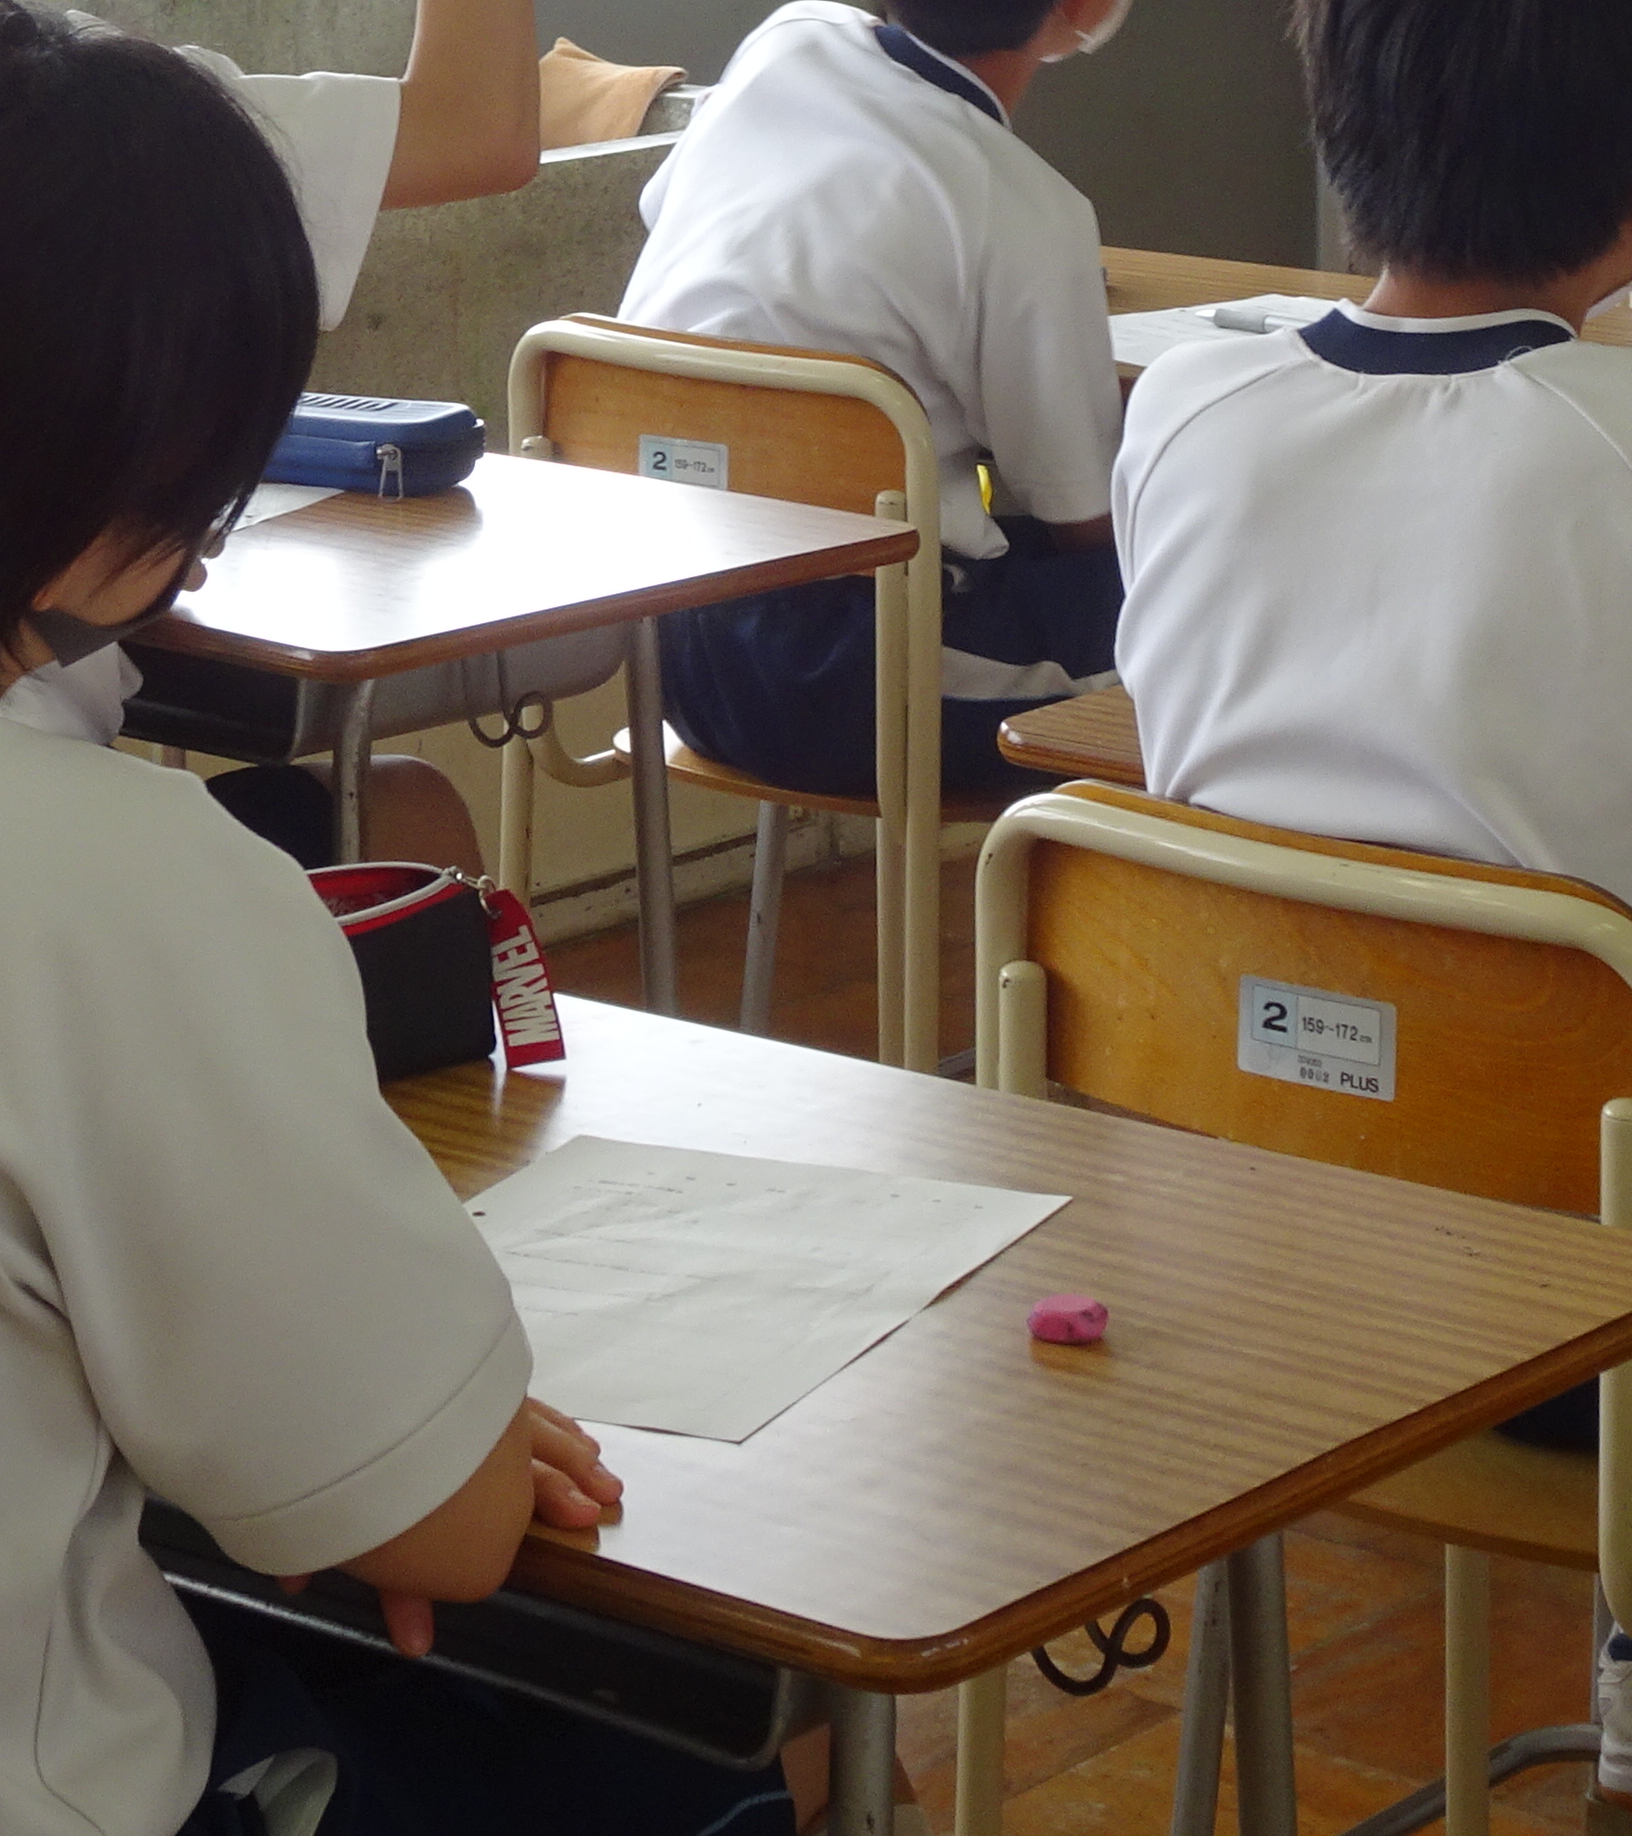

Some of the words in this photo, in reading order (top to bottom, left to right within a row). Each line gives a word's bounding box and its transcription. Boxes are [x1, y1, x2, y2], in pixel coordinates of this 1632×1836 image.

[652, 451, 669, 471] 2
[492, 924, 562, 1047] MARVEL
[1261, 1001, 1289, 1034] 2
[1340, 1071, 1380, 1094] PLUS
